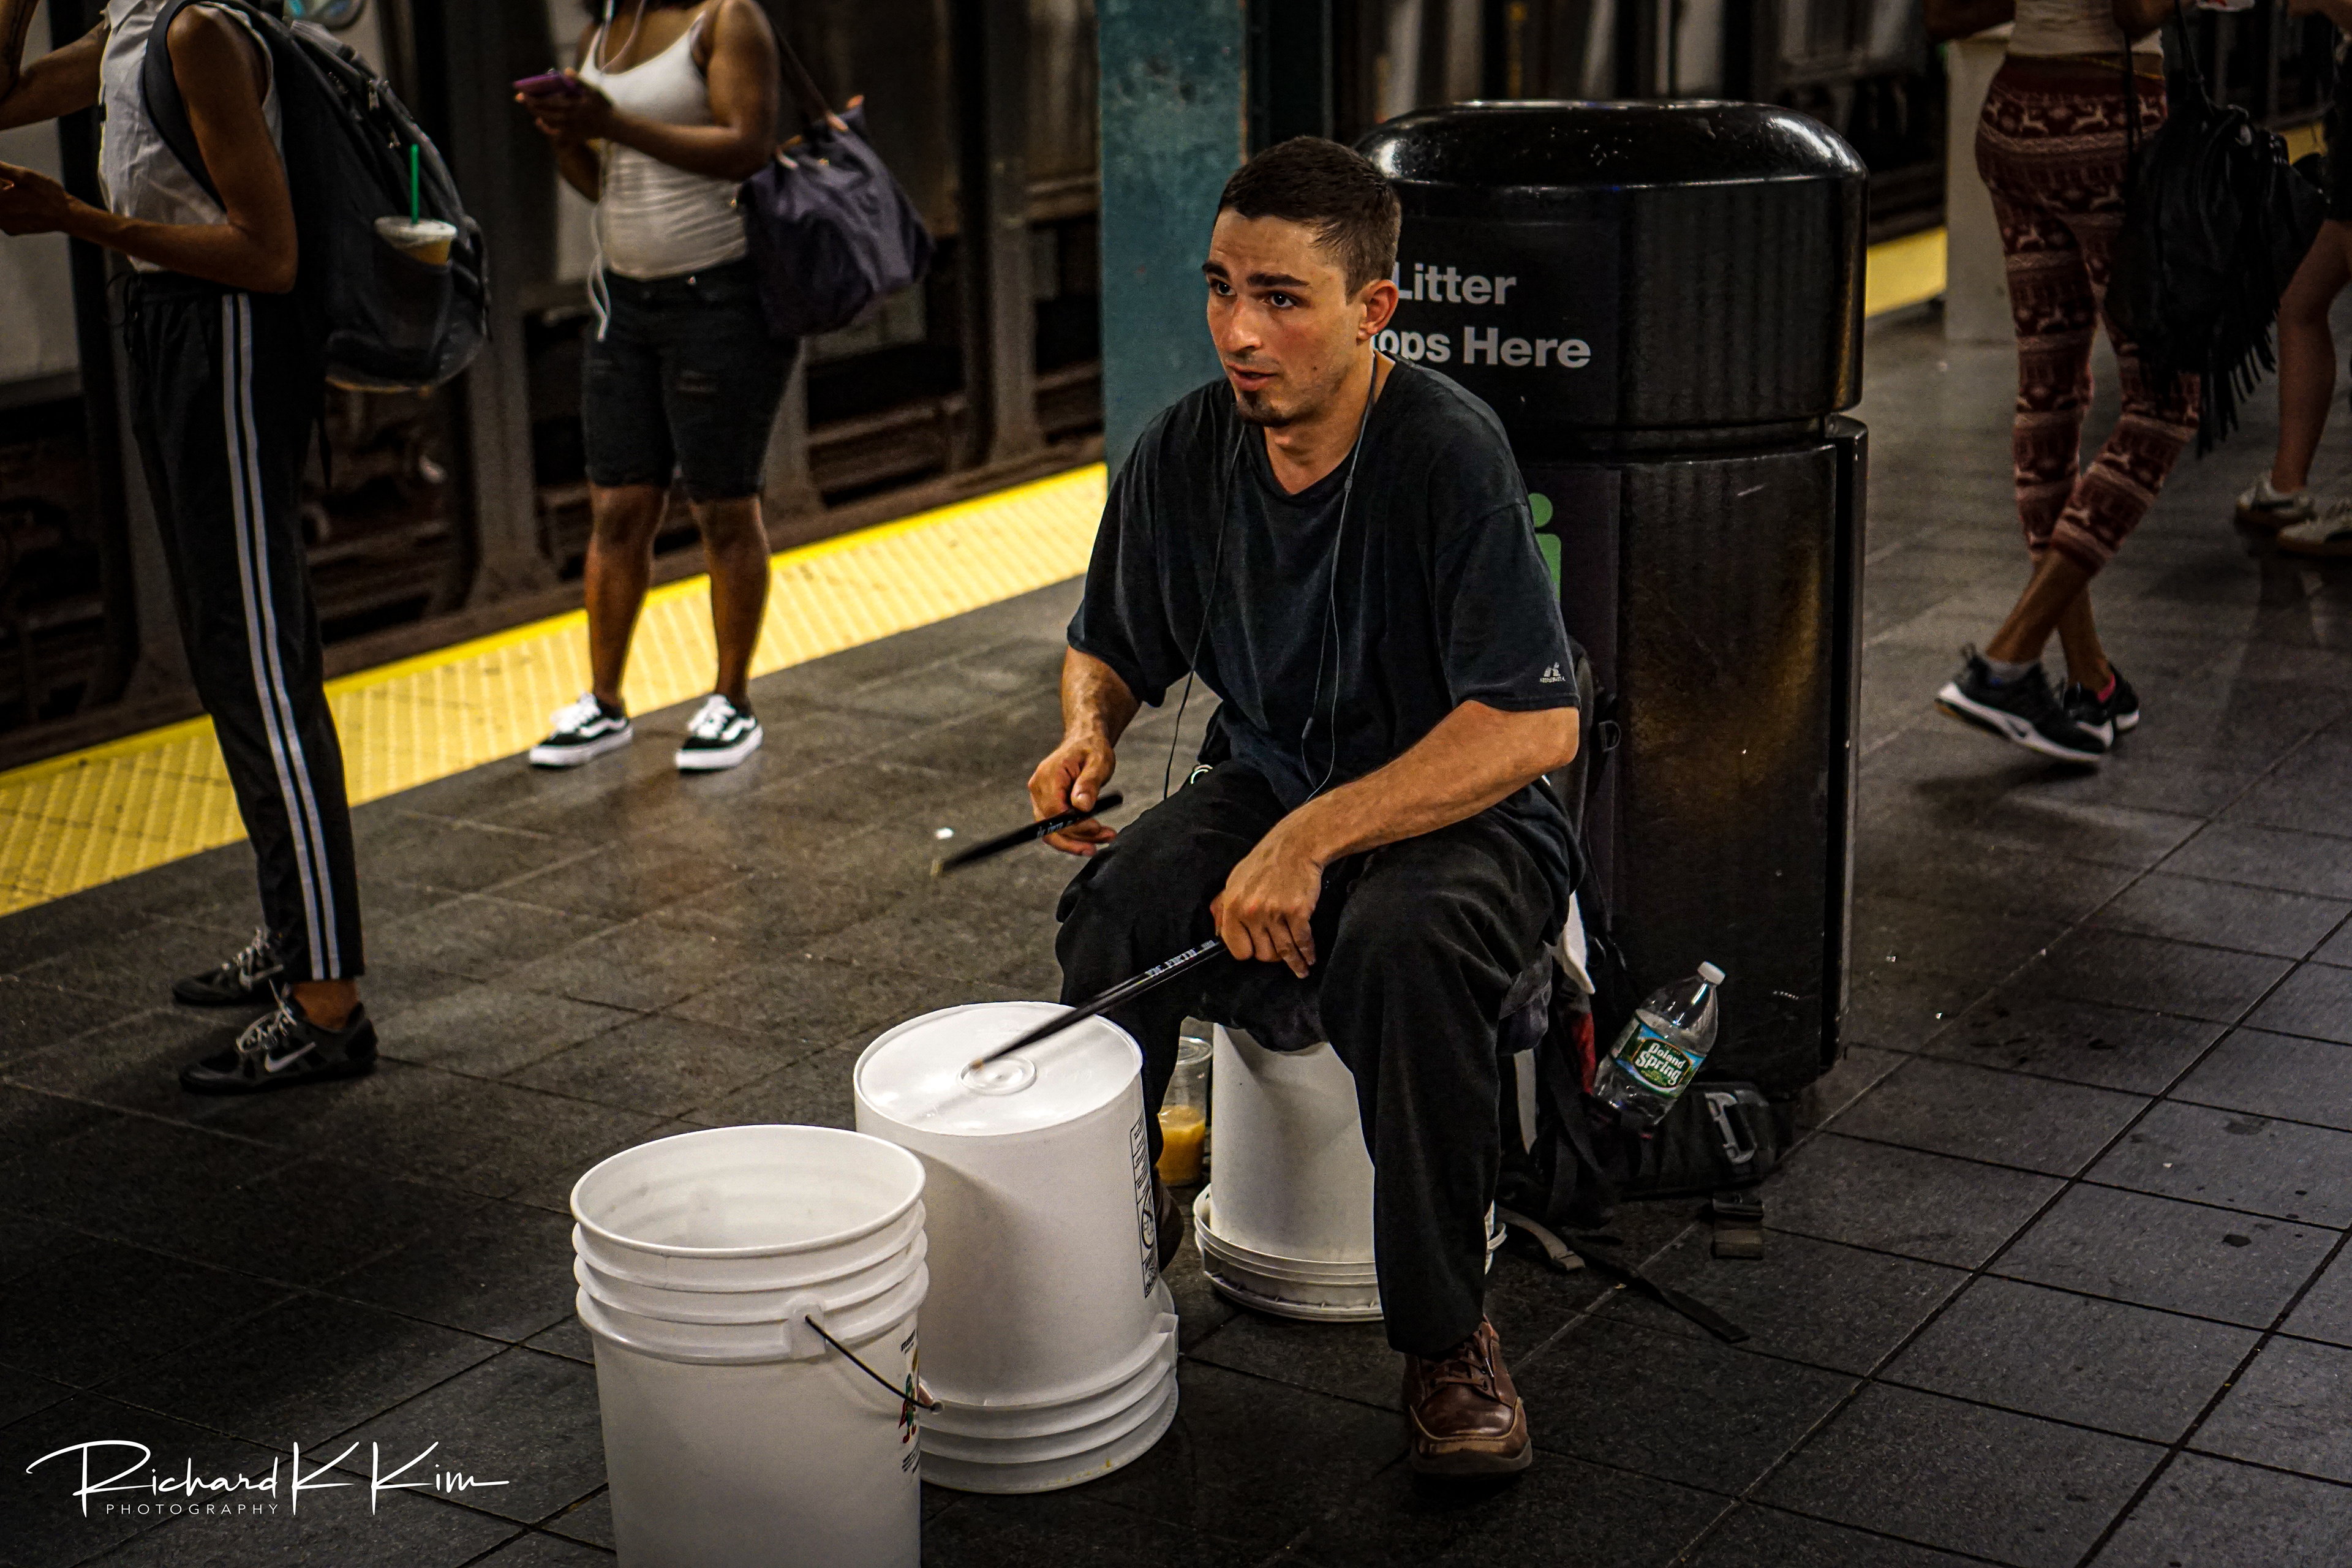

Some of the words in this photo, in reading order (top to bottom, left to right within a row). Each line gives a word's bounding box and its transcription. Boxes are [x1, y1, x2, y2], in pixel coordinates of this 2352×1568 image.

[1391, 261, 1517, 306] Litter
[1463, 325, 1592, 368] Here
[1635, 1050, 1683, 1085] Spring
[1648, 1042, 1687, 1069] Poland
